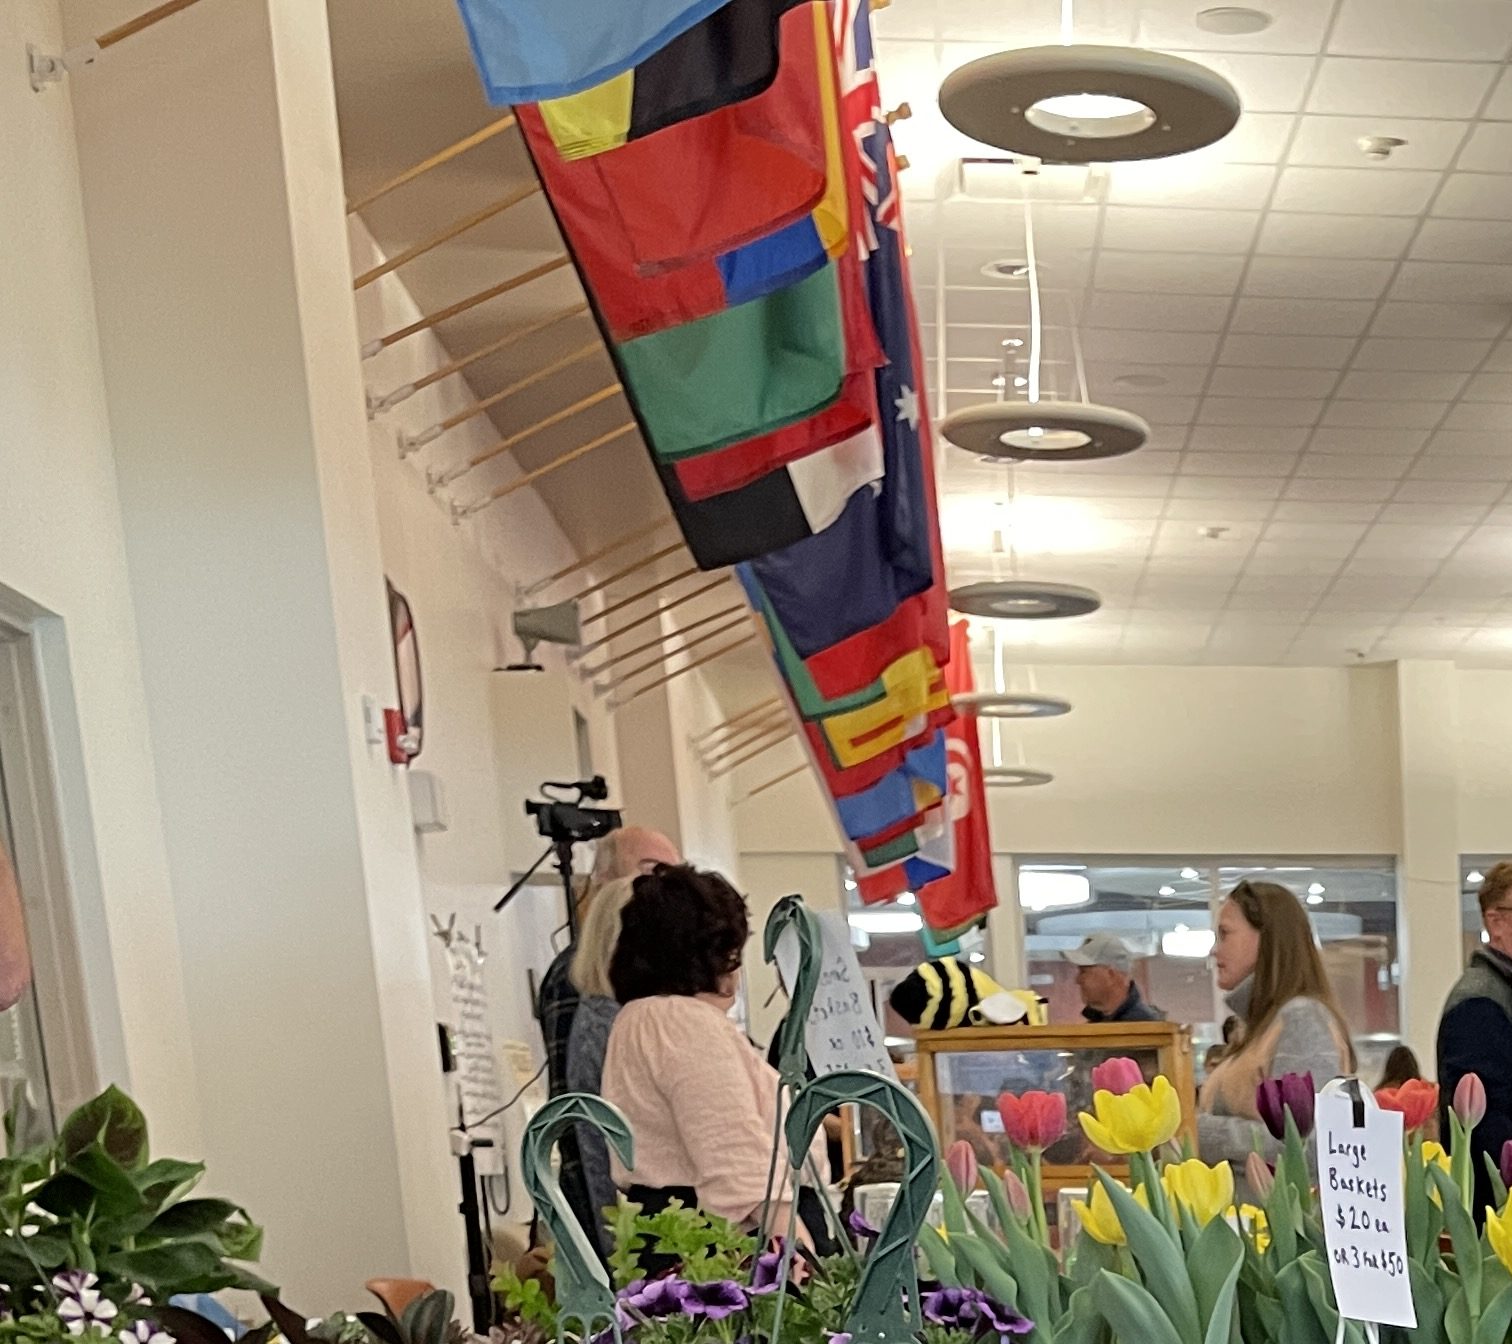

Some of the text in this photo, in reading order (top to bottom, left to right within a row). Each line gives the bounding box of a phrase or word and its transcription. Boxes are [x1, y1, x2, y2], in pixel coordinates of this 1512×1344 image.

[1328, 1131, 1367, 1168] Large
[1328, 1166, 1387, 1202] Baskets
[1336, 1203, 1390, 1234] $20 ea
[1351, 1245, 1360, 1269] 3
[1380, 1248, 1404, 1277] $50
